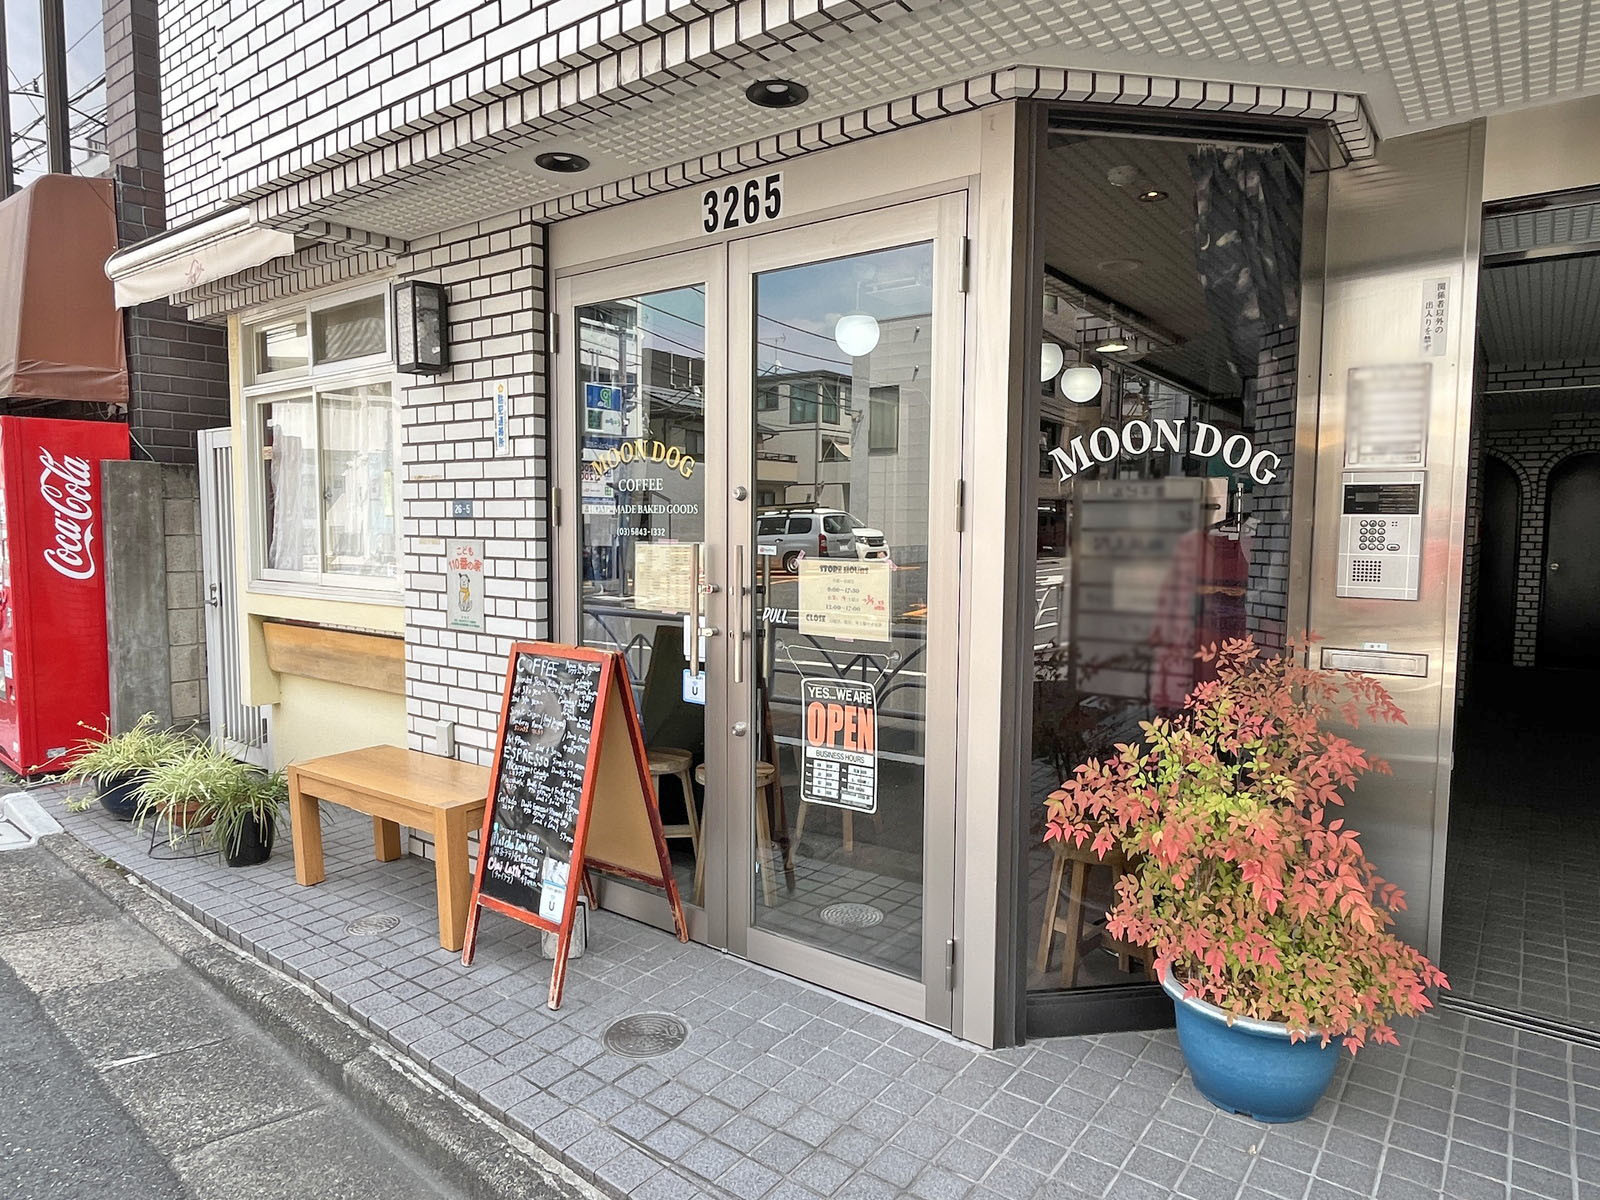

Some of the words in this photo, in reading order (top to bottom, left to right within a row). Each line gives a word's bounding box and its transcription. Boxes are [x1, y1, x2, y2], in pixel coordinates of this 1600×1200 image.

[703, 173, 781, 233] 3265
[1435, 282, 1446, 334] 関係者以外の
[591, 438, 649, 478] MOON
[650, 440, 696, 479] DOG
[1048, 418, 1186, 482] MOON
[1189, 421, 1282, 486] DOG
[618, 478, 664, 492] COFFEE
[39, 446, 96, 580] Coca-Cola
[454, 504, 471, 514] 26-5
[637, 504, 665, 514] BAKED
[666, 504, 699, 514] GOODS
[457, 546, 474, 557] こども
[448, 557, 482, 572] 110番の家
[762, 607, 789, 624] PULL
[805, 613, 826, 623] CLOSE
[517, 656, 559, 678] COFFEE
[853, 691, 873, 704] ARE
[807, 701, 874, 754] OPEN
[503, 745, 550, 768] ESPRESSO
[815, 749, 845, 761] BUSINESS
[845, 752, 865, 764] HOURS
[487, 856, 503, 873] Chai
